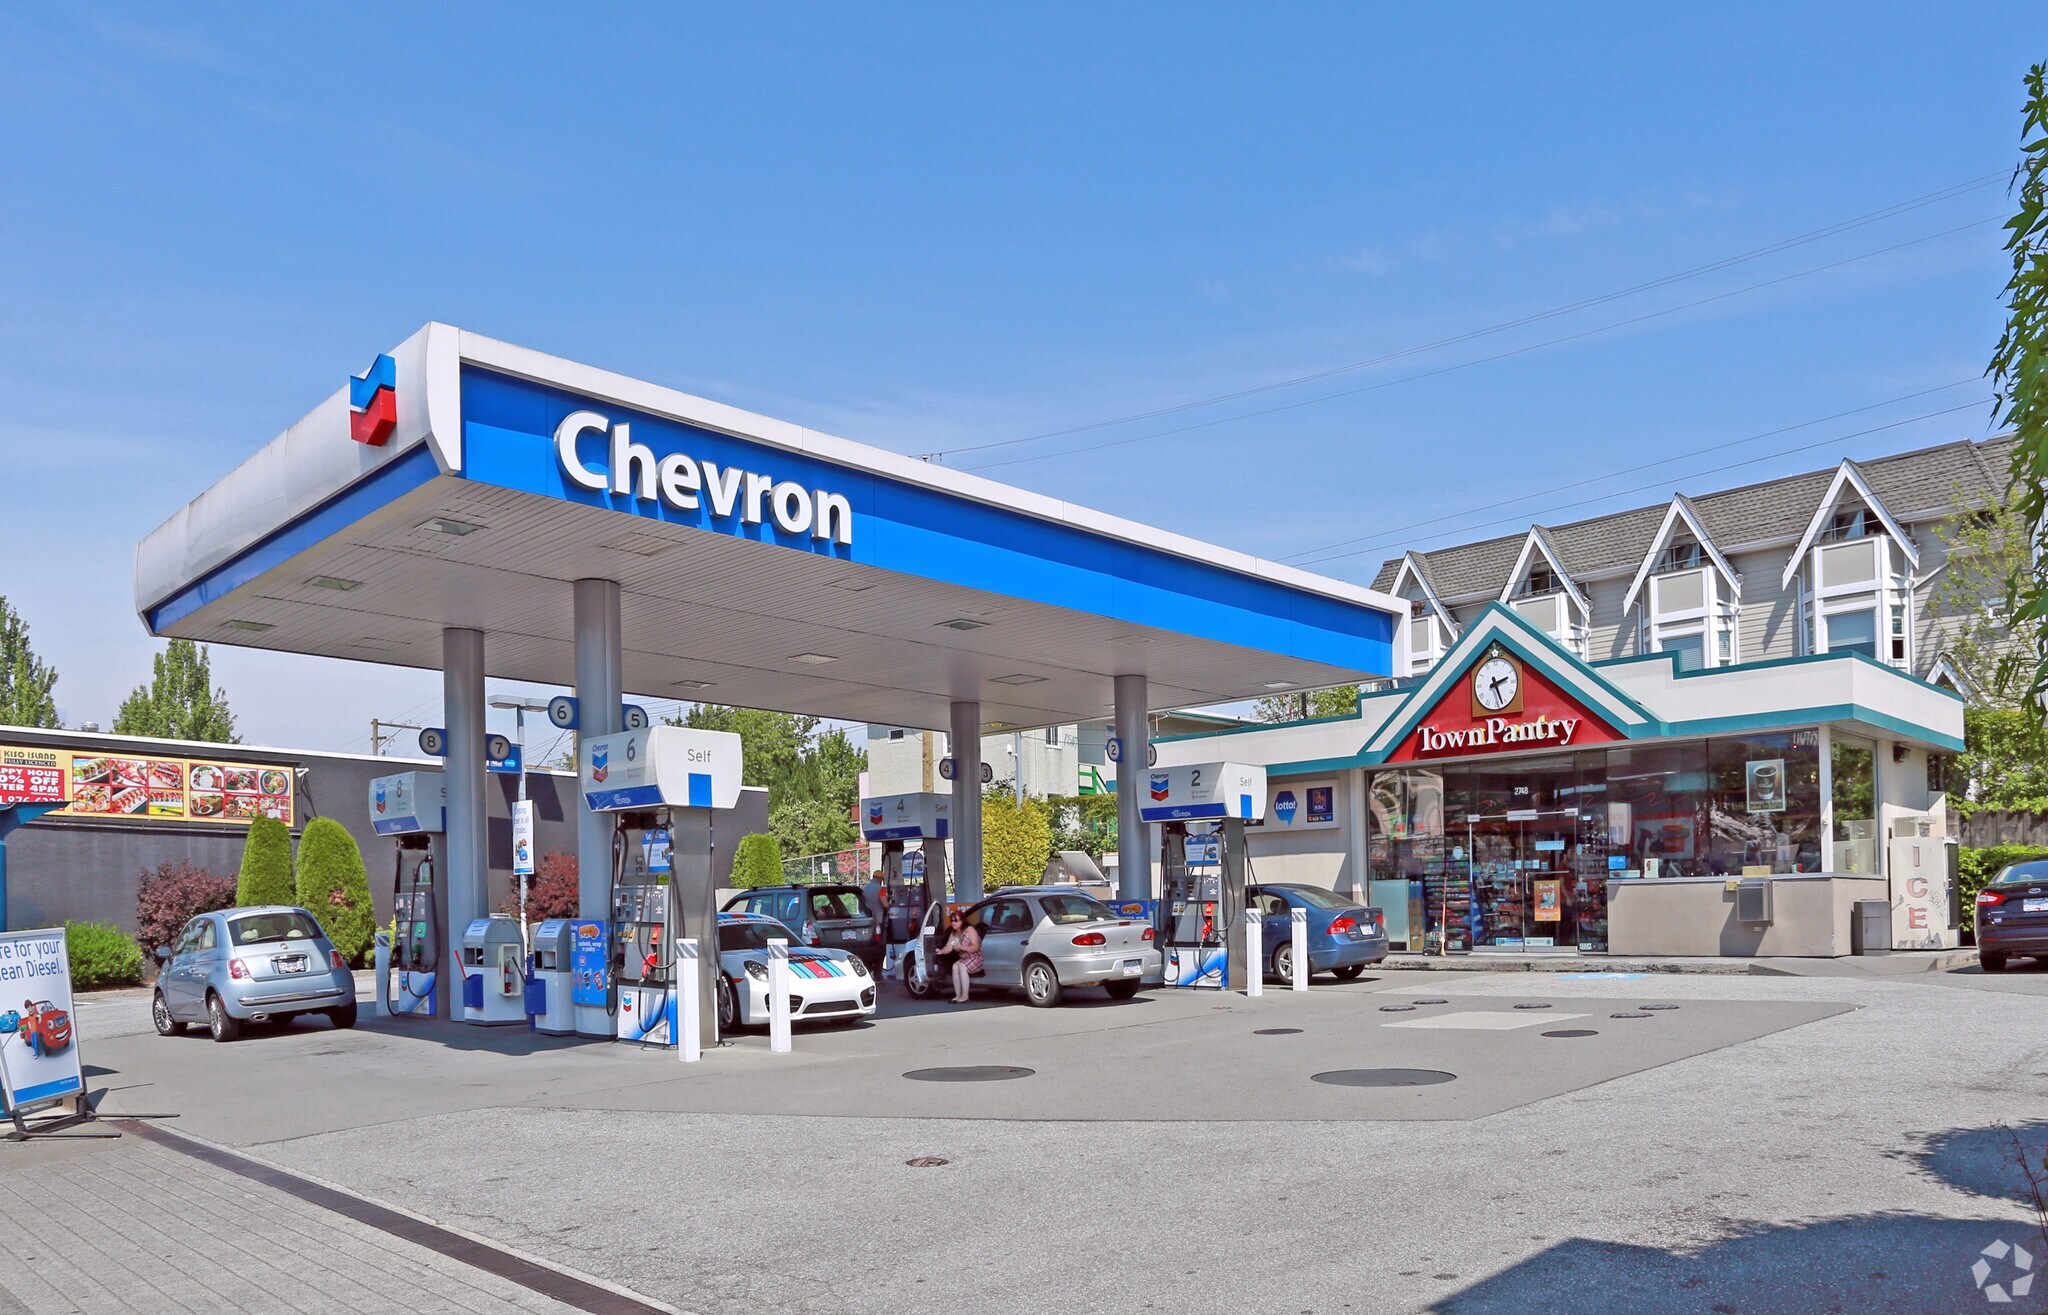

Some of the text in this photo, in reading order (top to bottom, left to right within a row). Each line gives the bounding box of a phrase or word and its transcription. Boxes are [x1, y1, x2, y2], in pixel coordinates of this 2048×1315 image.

[553, 410, 852, 545] Chevron
[557, 705, 567, 720] 6
[631, 713, 640, 728] 5
[1417, 715, 1579, 752] TownPantry
[426, 735, 437, 748] 8
[592, 743, 609, 752] Chevron
[4, 750, 57, 760] KISO ISLAND
[495, 742, 504, 755] 7
[626, 737, 636, 762] 6
[1111, 744, 1117, 756] 2
[687, 748, 712, 763] Self
[27, 769, 59, 777] HOUR
[943, 765, 950, 774] 4
[983, 769, 989, 778] 3
[30, 776, 59, 785] OFF
[1191, 769, 1201, 787] 2
[1240, 776, 1253, 787] Self
[29, 785, 59, 793] 4PM
[396, 780, 403, 798] 8
[1514, 787, 1529, 795] 2748
[897, 799, 904, 813] 4
[1906, 845, 1929, 930] ICE
[14, 940, 31, 957] for
[35, 940, 60, 960] your
[26, 957, 63, 978] Diesel.
